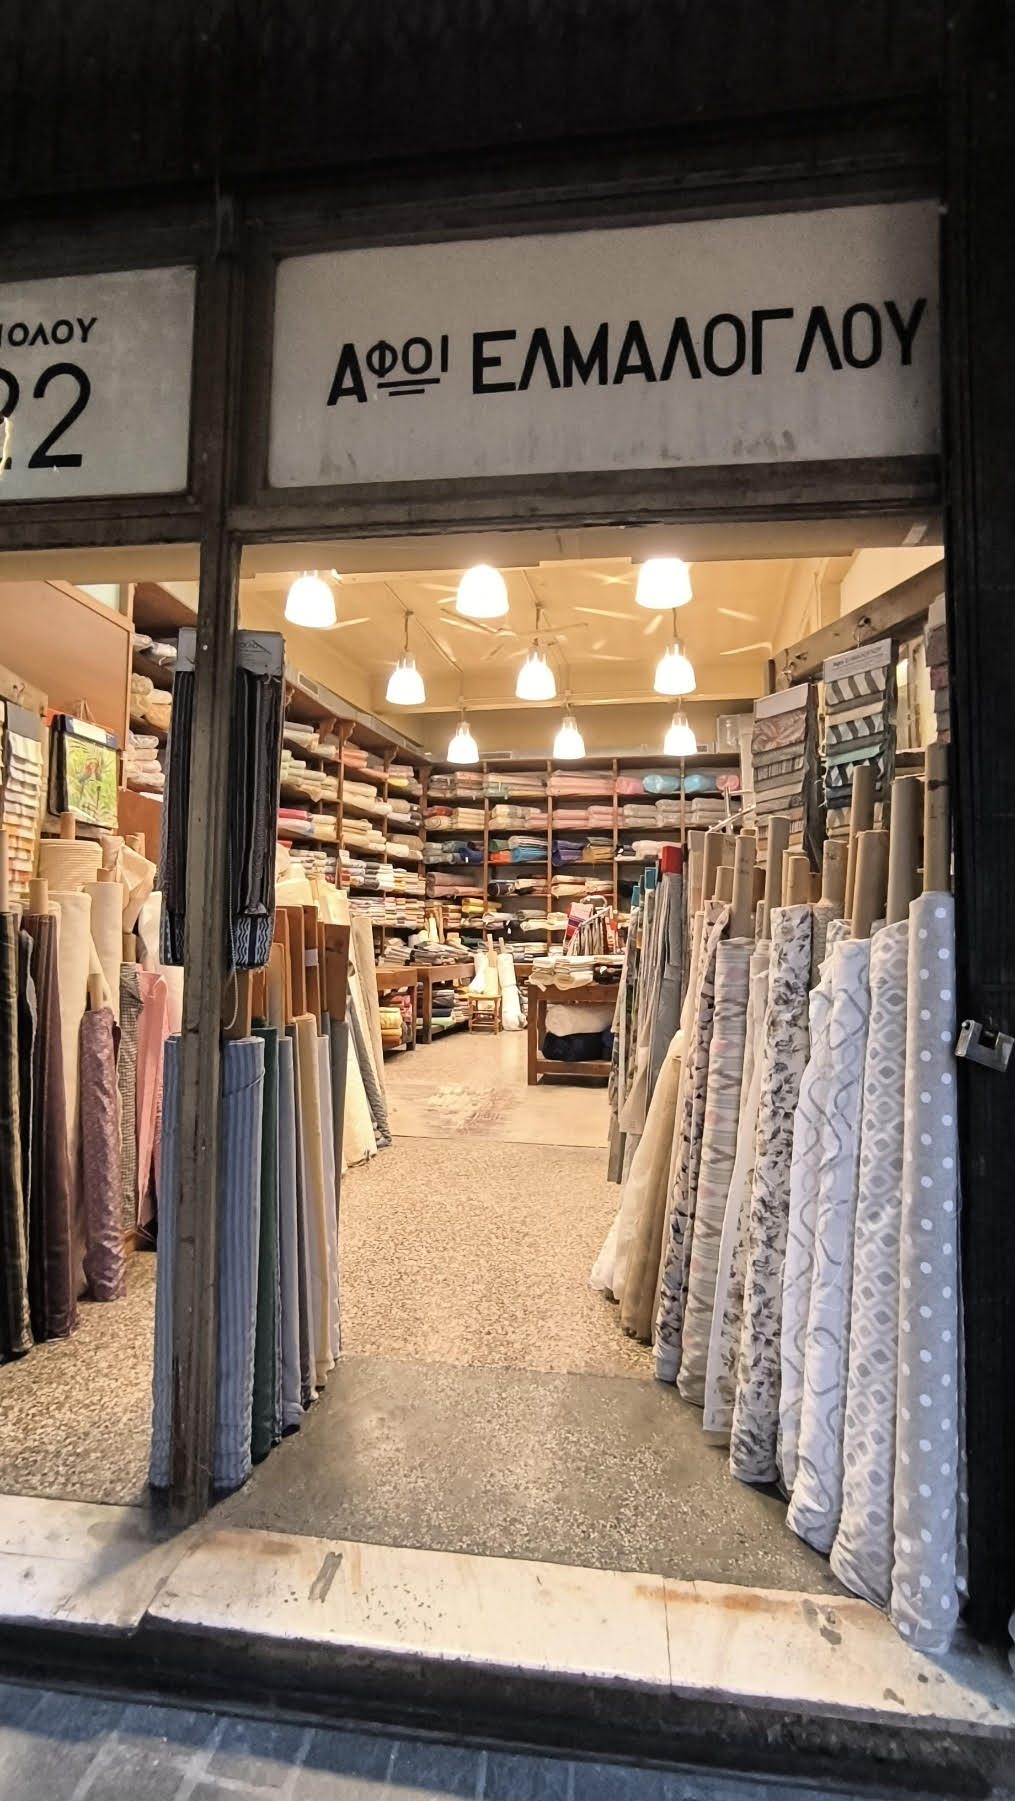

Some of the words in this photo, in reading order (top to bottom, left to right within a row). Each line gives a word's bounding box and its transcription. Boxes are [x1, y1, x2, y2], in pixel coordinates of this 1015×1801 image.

[0, 317, 98, 347] ΟΛΟΥ
[327, 335, 448, 406] ΑΦΟΙ
[473, 298, 927, 394] ΕΛΜΑΛΟΓΛΟΥ
